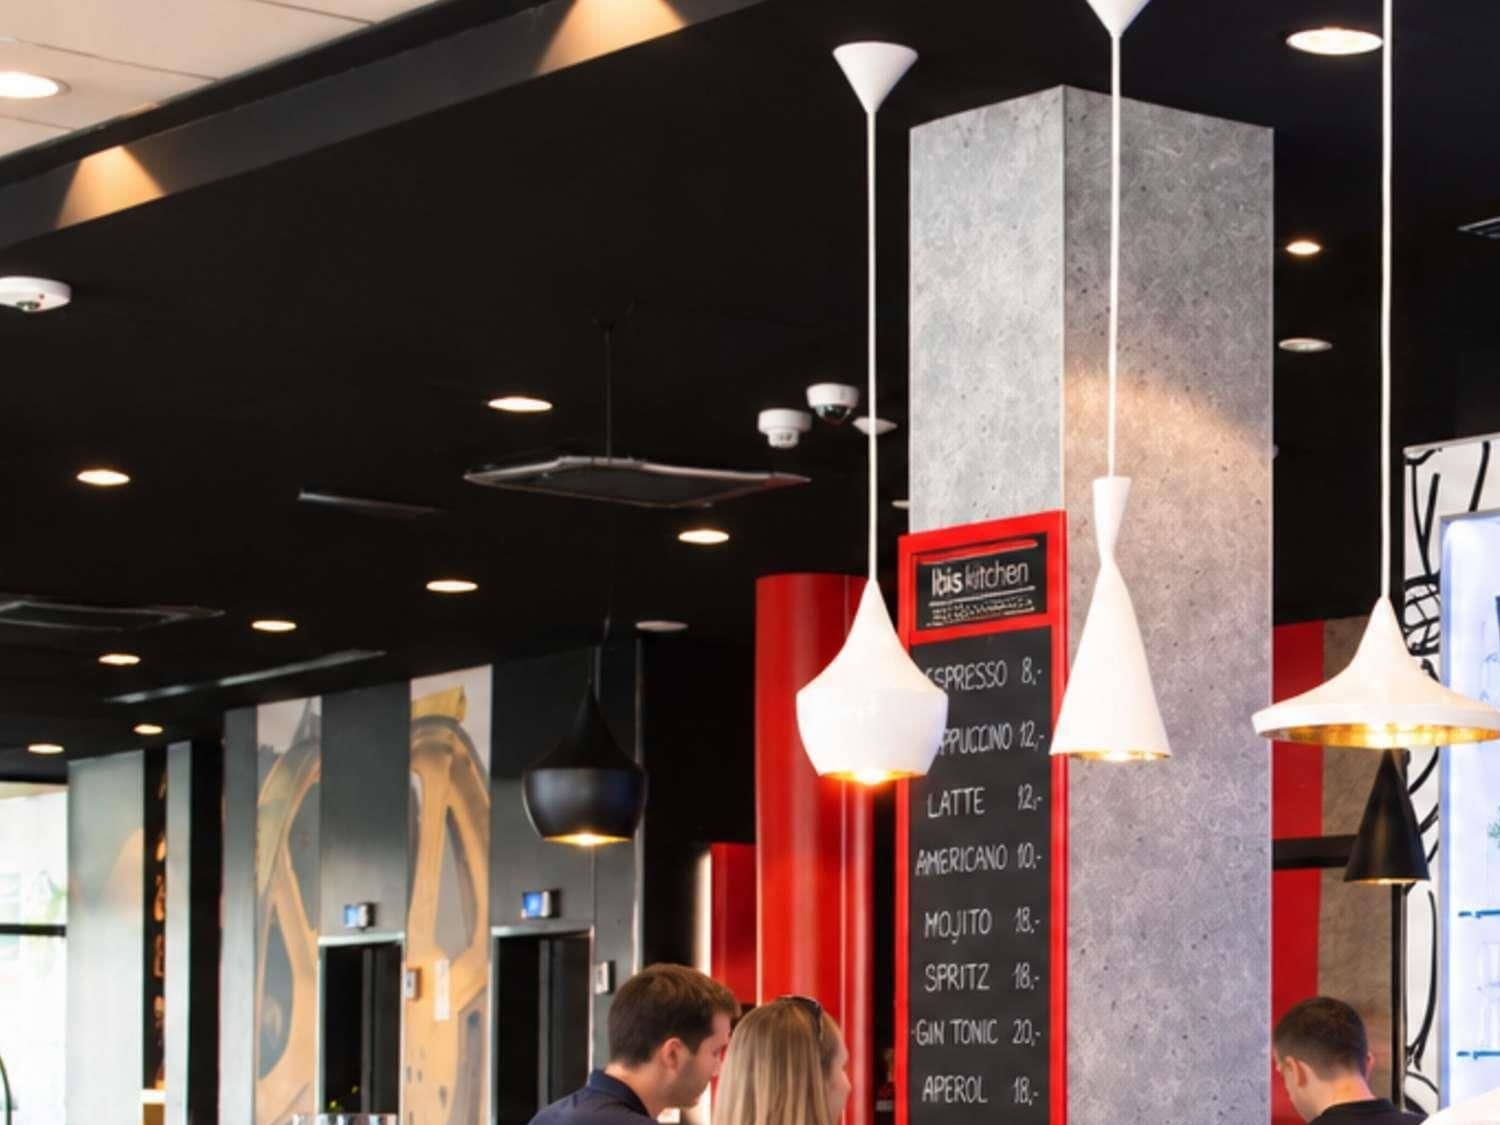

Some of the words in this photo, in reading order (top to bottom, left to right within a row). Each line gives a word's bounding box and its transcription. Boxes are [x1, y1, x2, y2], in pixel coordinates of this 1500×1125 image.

[965, 560, 1029, 590] kitchen
[927, 787, 986, 818] LATTE
[915, 844, 1008, 876] AMERICANO
[924, 908, 992, 944] MOJITO
[924, 963, 990, 992] SPRITZ
[951, 1018, 998, 1045] TONIC
[922, 1075, 988, 1103] APEROL
